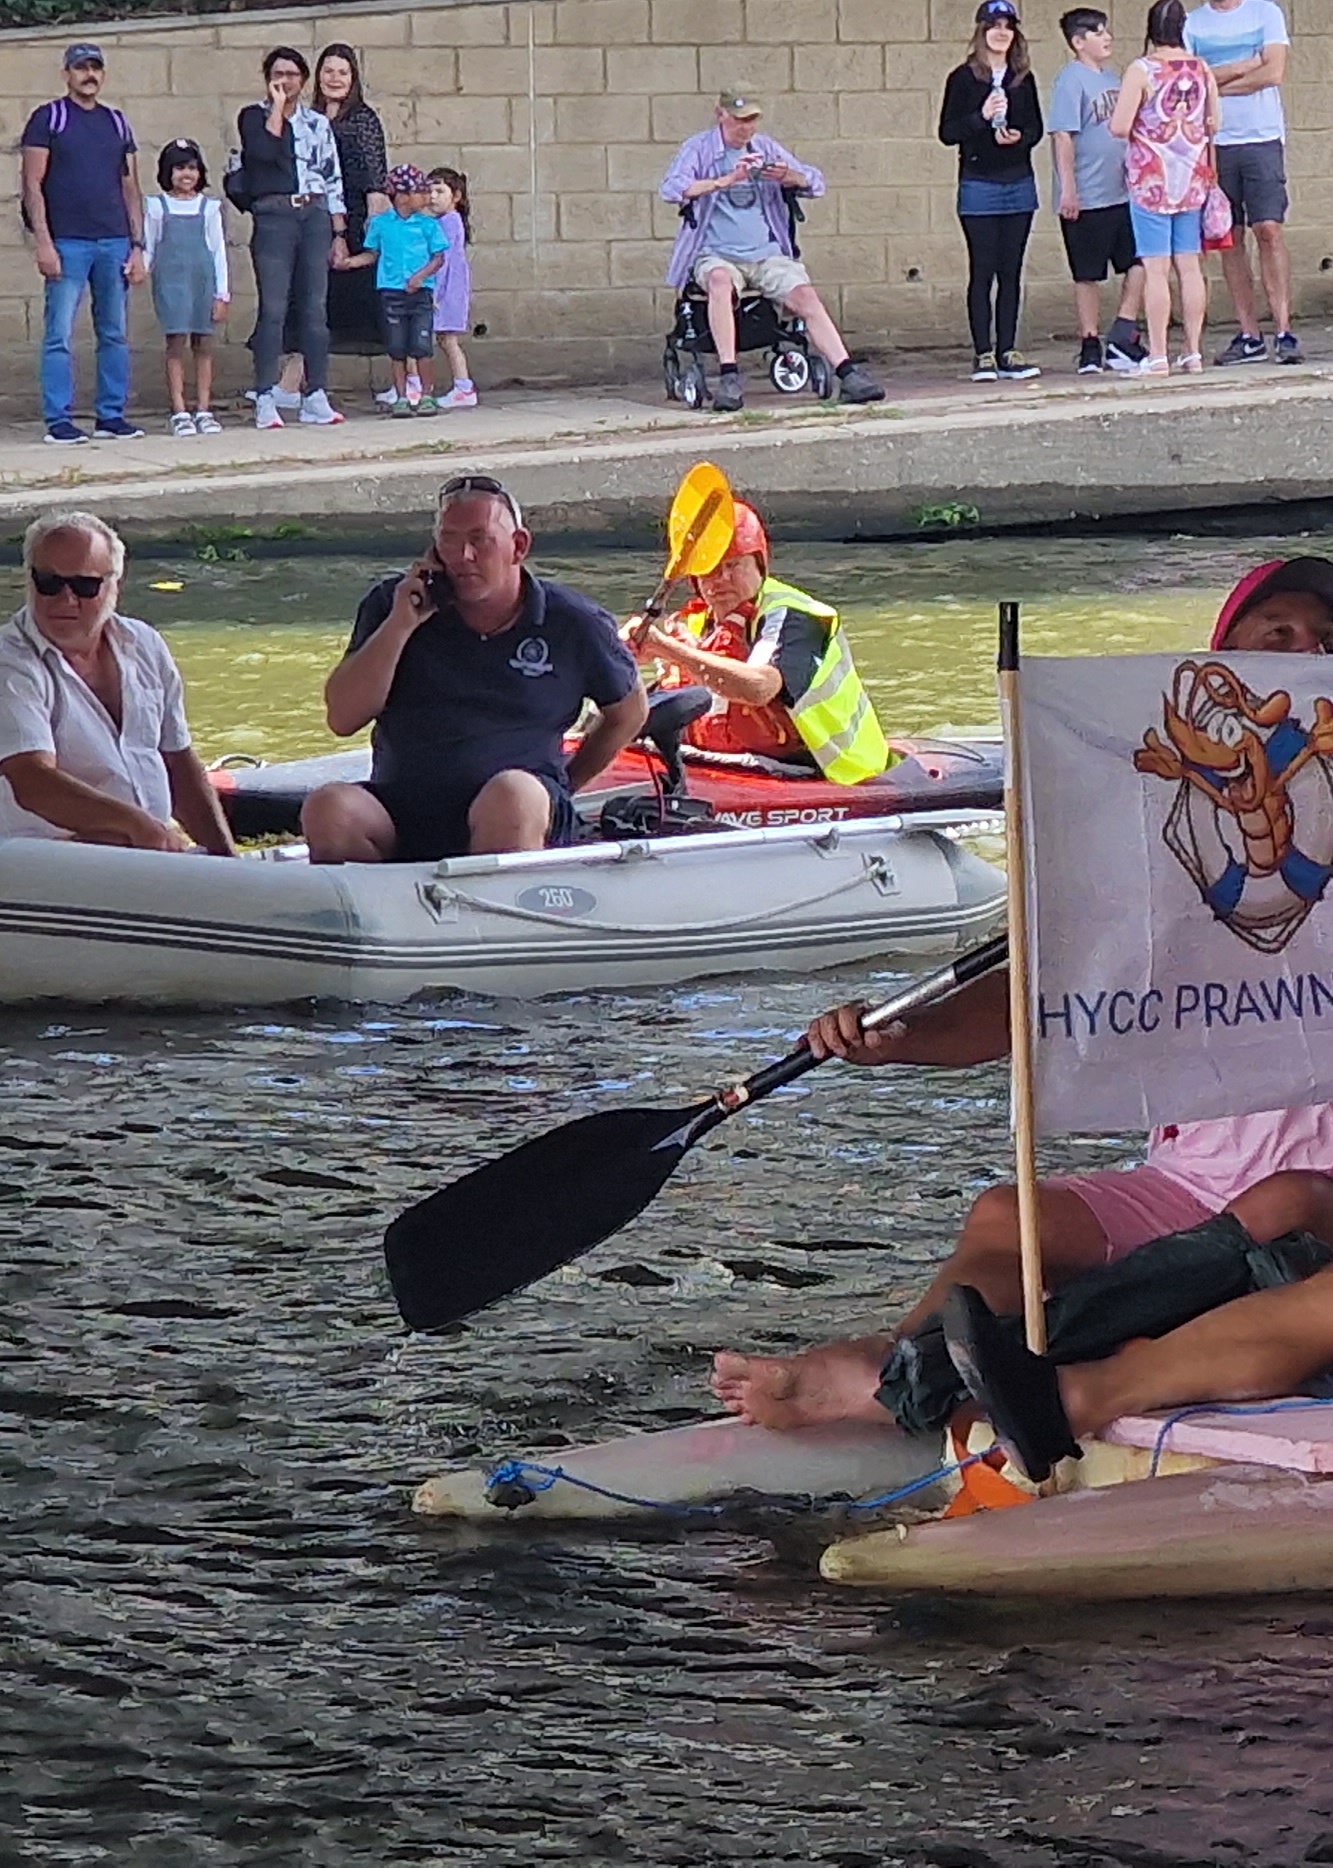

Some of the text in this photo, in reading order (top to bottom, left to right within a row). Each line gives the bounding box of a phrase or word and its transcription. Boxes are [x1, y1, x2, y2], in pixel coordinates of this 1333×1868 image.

[766, 807, 849, 825] SPORT
[538, 888, 574, 907] 260
[1038, 989, 1162, 1038] HYCC
